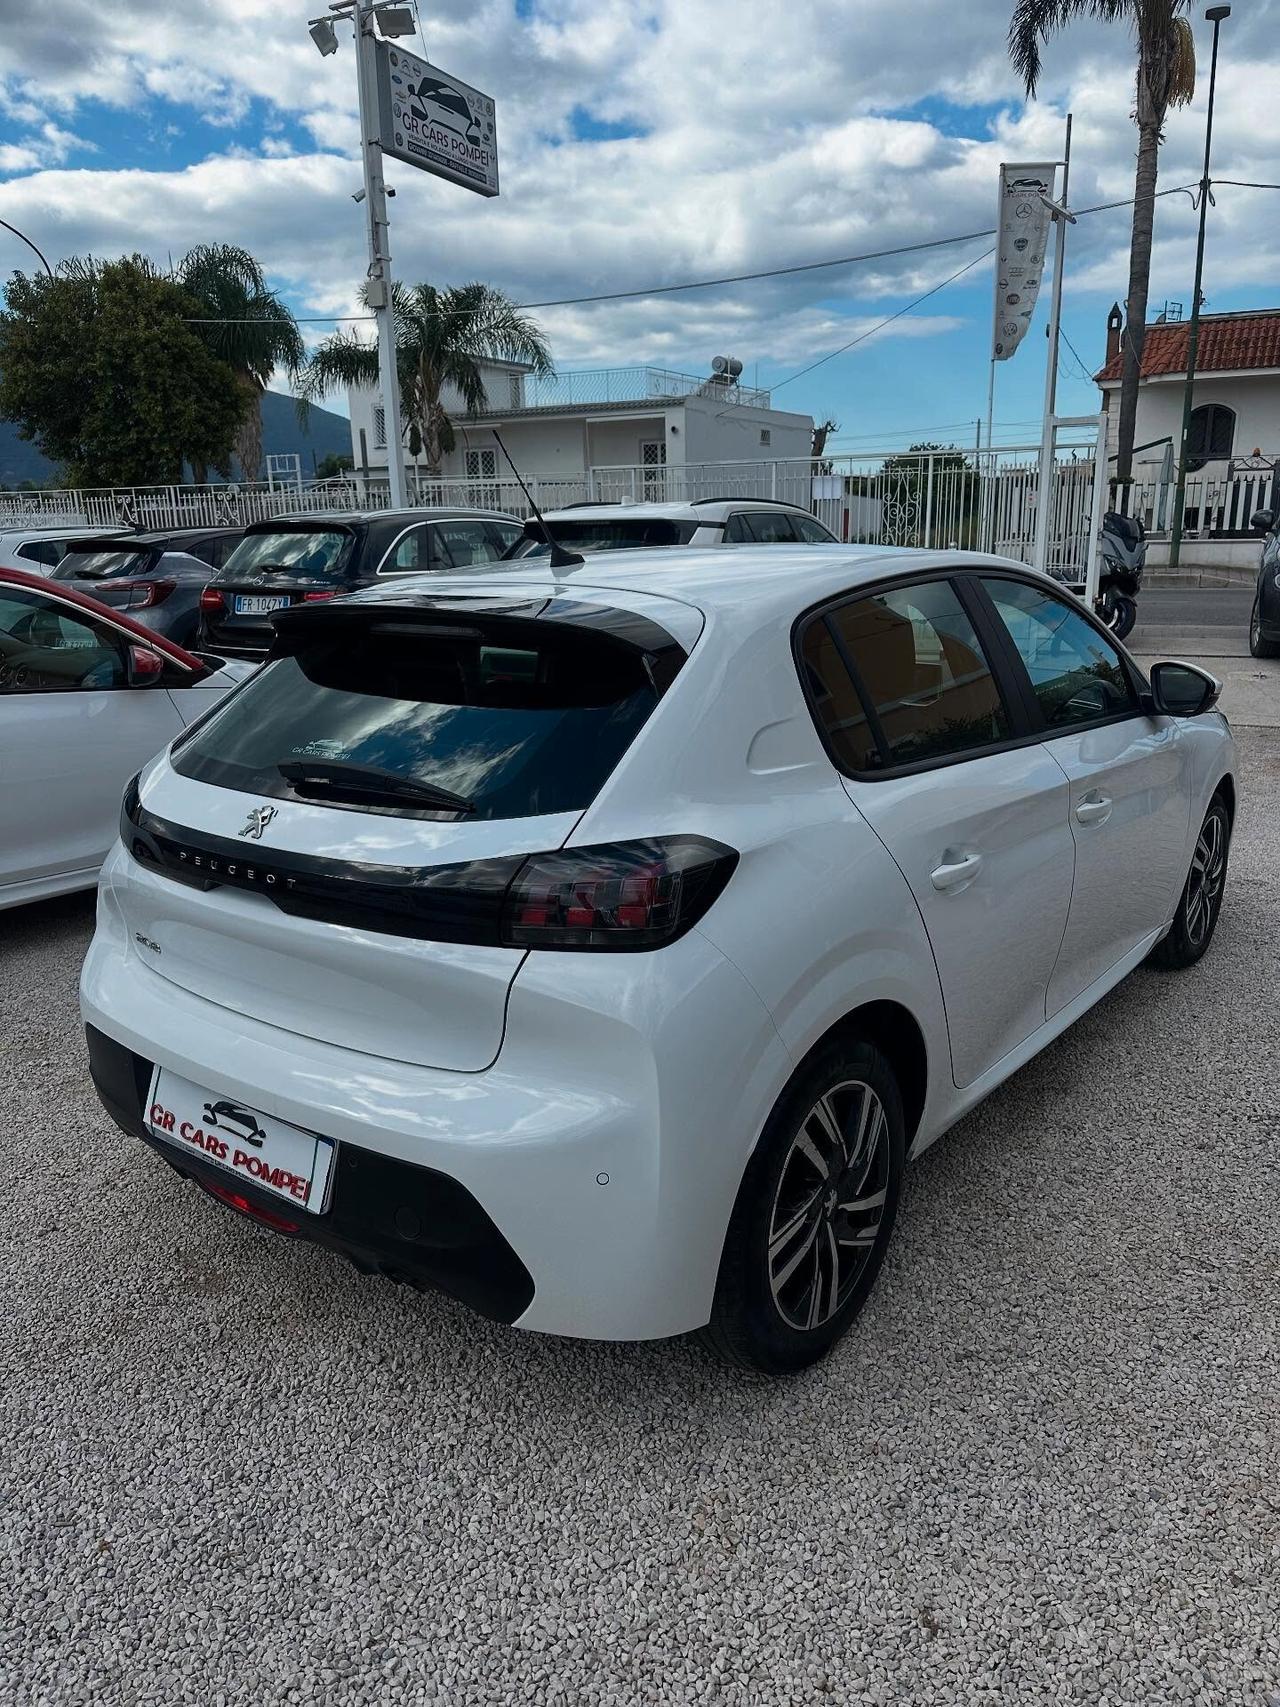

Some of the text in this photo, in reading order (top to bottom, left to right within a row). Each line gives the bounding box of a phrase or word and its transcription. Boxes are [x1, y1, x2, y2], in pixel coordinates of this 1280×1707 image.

[402, 112, 419, 134] GR
[421, 124, 449, 147] CARS
[451, 138, 489, 167] POMPEI
[243, 599, 253, 610] FR
[179, 852, 297, 889] PEUGEOT
[149, 1104, 176, 1132] GR
[179, 1122, 230, 1160] CARS
[232, 1149, 312, 1201] POMPEI
